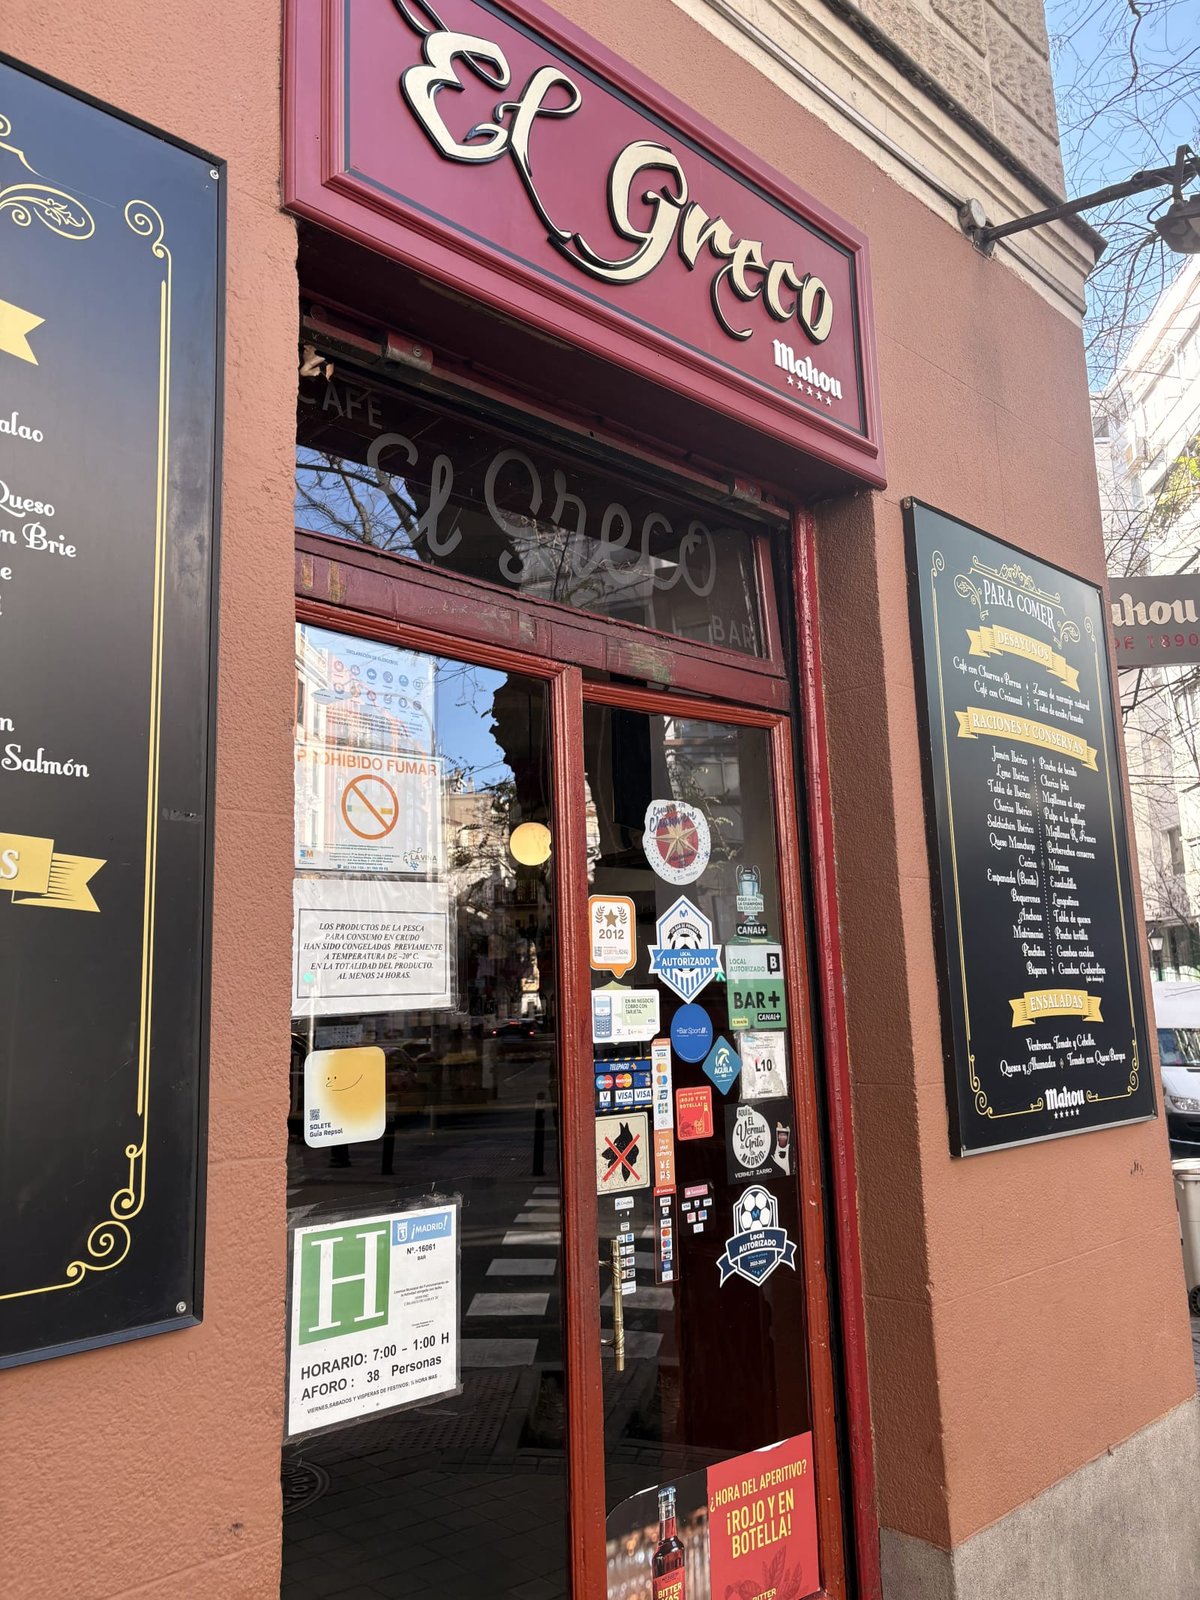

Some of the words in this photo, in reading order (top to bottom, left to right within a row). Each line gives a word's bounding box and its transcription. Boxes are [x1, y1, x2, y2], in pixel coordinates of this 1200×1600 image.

[397, 0, 583, 241] El
[548, 139, 834, 345] Greco
[772, 338, 843, 400] Mahou
[22, 521, 77, 557] Brie
[983, 579, 1015, 608] PARA
[1016, 594, 1056, 633] COMER
[997, 631, 1050, 661] DESAYUNOS
[1147, 633, 1200, 649] 1890
[972, 713, 1022, 734] RACIONES
[1024, 724, 1030, 736] Y
[1032, 726, 1084, 755] CONSERVAS
[2, 743, 90, 778] Salmón
[387, 759, 437, 777] FUMAR
[319, 922, 334, 931] LOS
[335, 923, 379, 931] PRODUCTOS
[392, 924, 401, 932] LA
[402, 924, 425, 932] PESCA
[598, 928, 625, 940] 2012
[737, 925, 767, 935] CANAL+
[341, 943, 391, 951] CONGELADOS
[393, 943, 443, 951] PREVIAMENTE
[662, 956, 710, 967] AUTORIZADO
[729, 957, 747, 965] LOCAL
[769, 954, 778, 969] B
[729, 965, 766, 973] AUTORIZADO
[337, 972, 347, 980] AL
[348, 972, 375, 980] MENOS
[1030, 992, 1083, 1012] ENSALADAS
[757, 1013, 781, 1021] CANAL+
[754, 1059, 772, 1073] L10
[617, 1091, 633, 1099] VISA
[636, 1090, 651, 1098] VISA
[1044, 1086, 1085, 1110] Mahou
[309, 1122, 331, 1130] SOLETE
[323, 1128, 343, 1137] Repsol
[741, 1151, 765, 1166] MADRID
[749, 1231, 765, 1241] Local
[739, 1239, 777, 1253] AUTORIZADO
[308, 1230, 387, 1333] H
[301, 1353, 367, 1380] HORARIO:
[373, 1344, 397, 1361] 7:00
[412, 1334, 436, 1352] 1:00
[441, 1332, 449, 1344] H
[366, 1369, 380, 1383] 38
[391, 1354, 442, 1377] Personas
[709, 1484, 740, 1513] ¿HORA
[742, 1480, 758, 1497] DEL
[760, 1459, 807, 1493] APERITIVO?
[727, 1501, 765, 1536] ¡ROJO
[767, 1495, 775, 1517] Y
[779, 1488, 795, 1513] EN
[732, 1514, 792, 1560] BOTELLA!
[658, 1582, 682, 1598] BITTER
